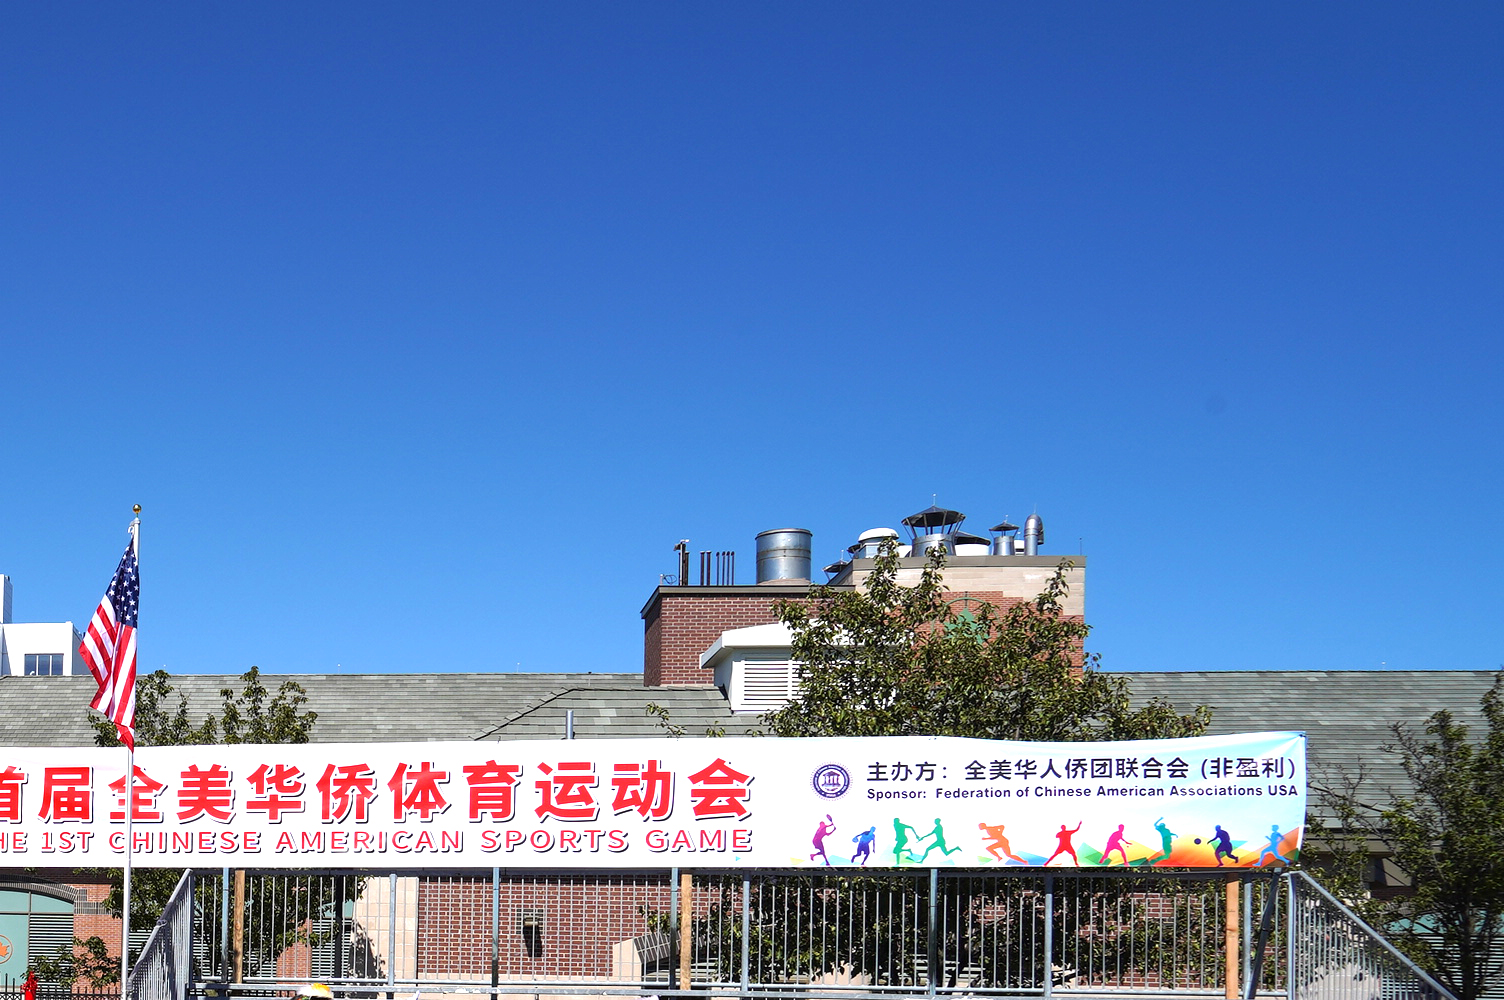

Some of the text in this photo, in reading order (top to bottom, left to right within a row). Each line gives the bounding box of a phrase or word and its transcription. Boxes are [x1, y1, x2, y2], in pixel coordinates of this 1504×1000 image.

[867, 784, 1298, 801] Sponsor: Federation of Chinese American Associations USA
[41, 831, 95, 854] 1ST
[108, 831, 262, 854] CHINESE
[275, 831, 464, 854] AMERICAN
[481, 830, 630, 854] SPORTS
[645, 829, 753, 854] GAME
